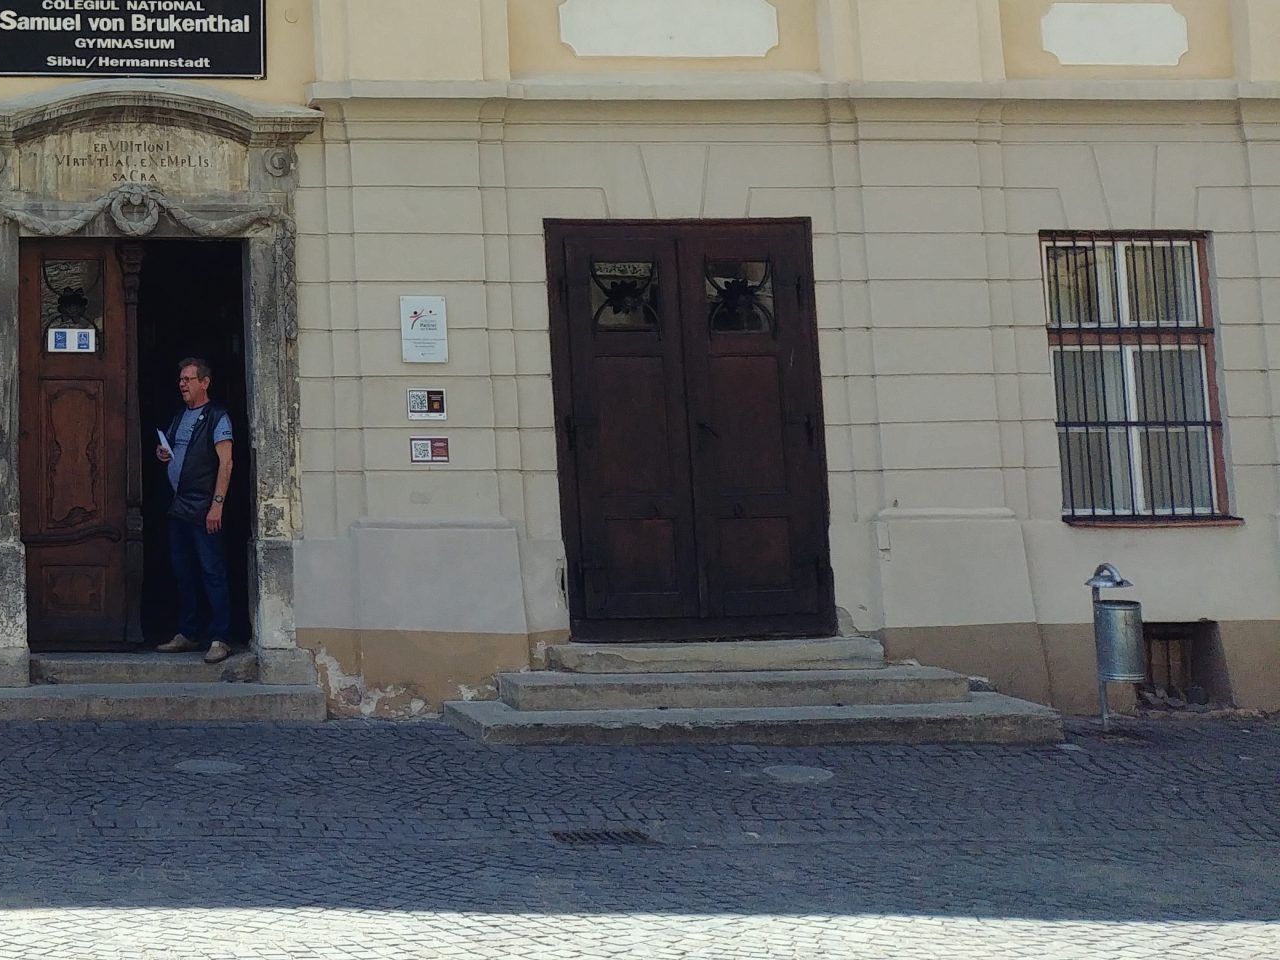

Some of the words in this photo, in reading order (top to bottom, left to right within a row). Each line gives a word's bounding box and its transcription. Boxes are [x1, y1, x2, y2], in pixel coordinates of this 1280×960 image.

[42, 0, 120, 11] COLEGIUL
[88, 17, 124, 32] von
[131, 14, 250, 33] Brukenthal
[74, 38, 175, 49] GYMNASIUM
[111, 169, 158, 182] SACRA
